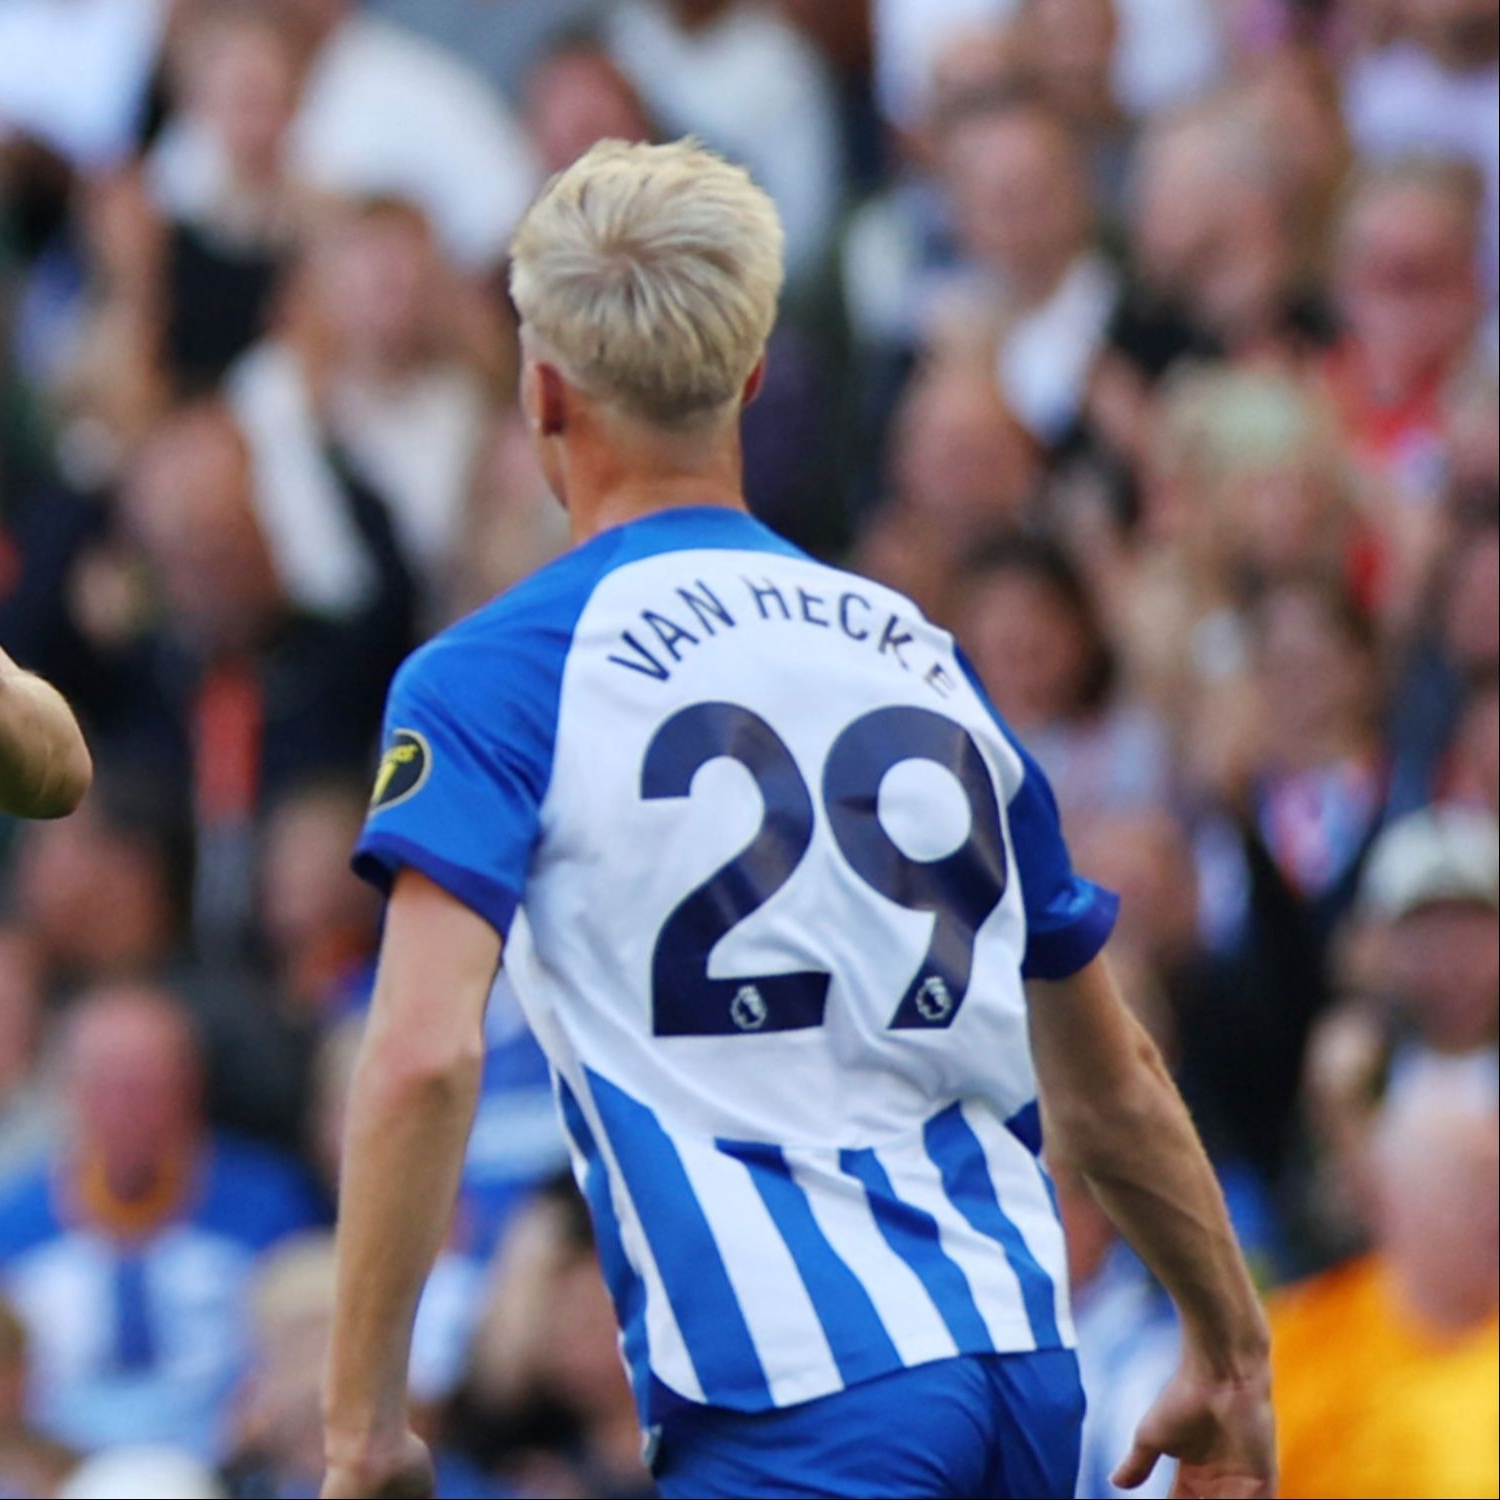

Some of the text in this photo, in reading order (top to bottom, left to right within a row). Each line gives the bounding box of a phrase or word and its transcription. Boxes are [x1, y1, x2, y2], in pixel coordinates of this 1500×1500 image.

[606, 575, 957, 699] VAN HECKE
[639, 701, 1009, 1038] 29
